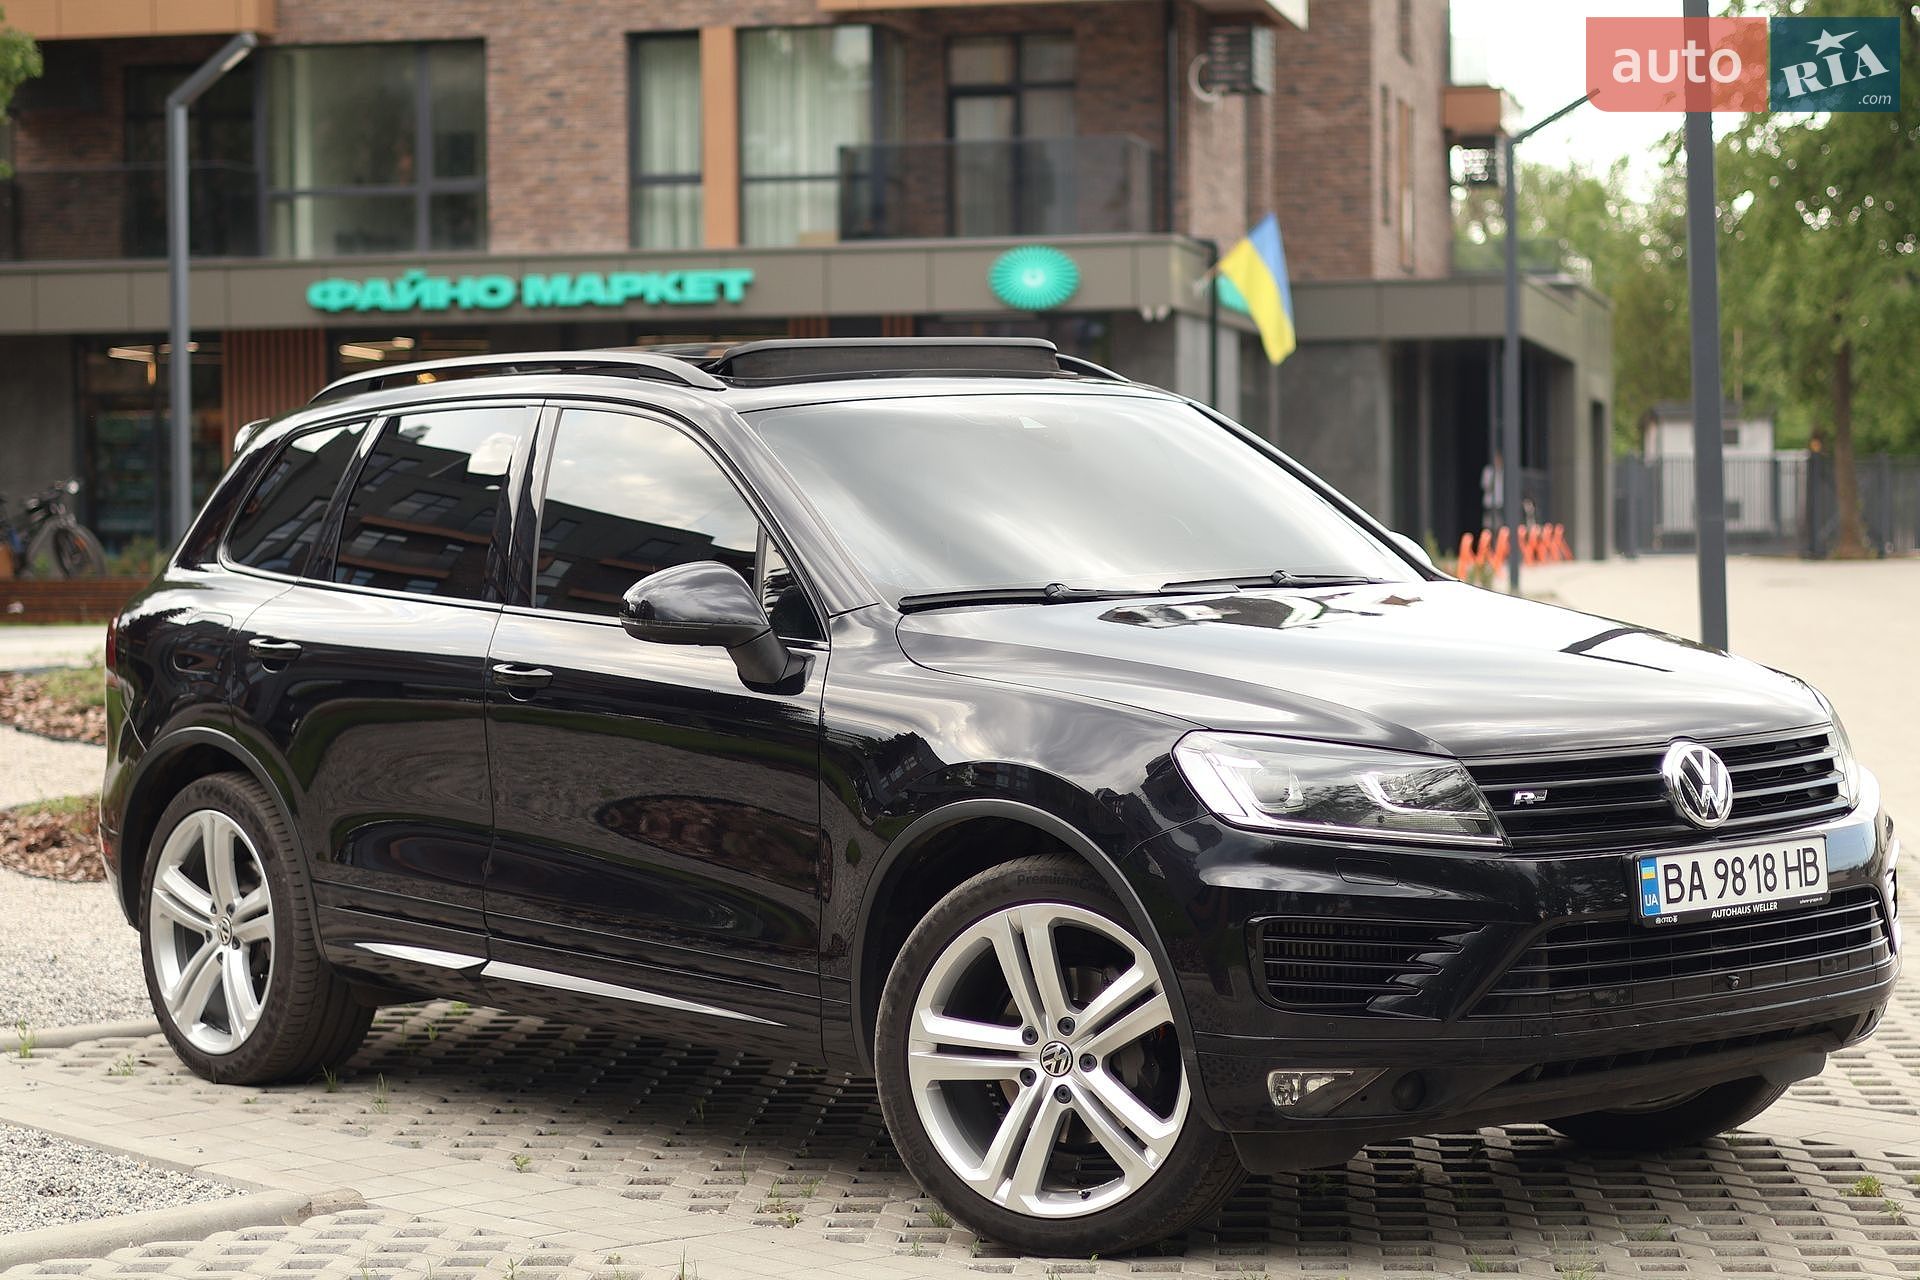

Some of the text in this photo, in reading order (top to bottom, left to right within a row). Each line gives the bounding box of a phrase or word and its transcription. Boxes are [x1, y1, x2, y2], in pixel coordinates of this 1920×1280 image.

[306, 268, 754, 312] ФАЙНО МАРКЕТ
[1663, 847, 1820, 904] BA 9818 HB
[1644, 894, 1659, 907] UA
[1711, 901, 1778, 919] AUTOHAUS WELLER
